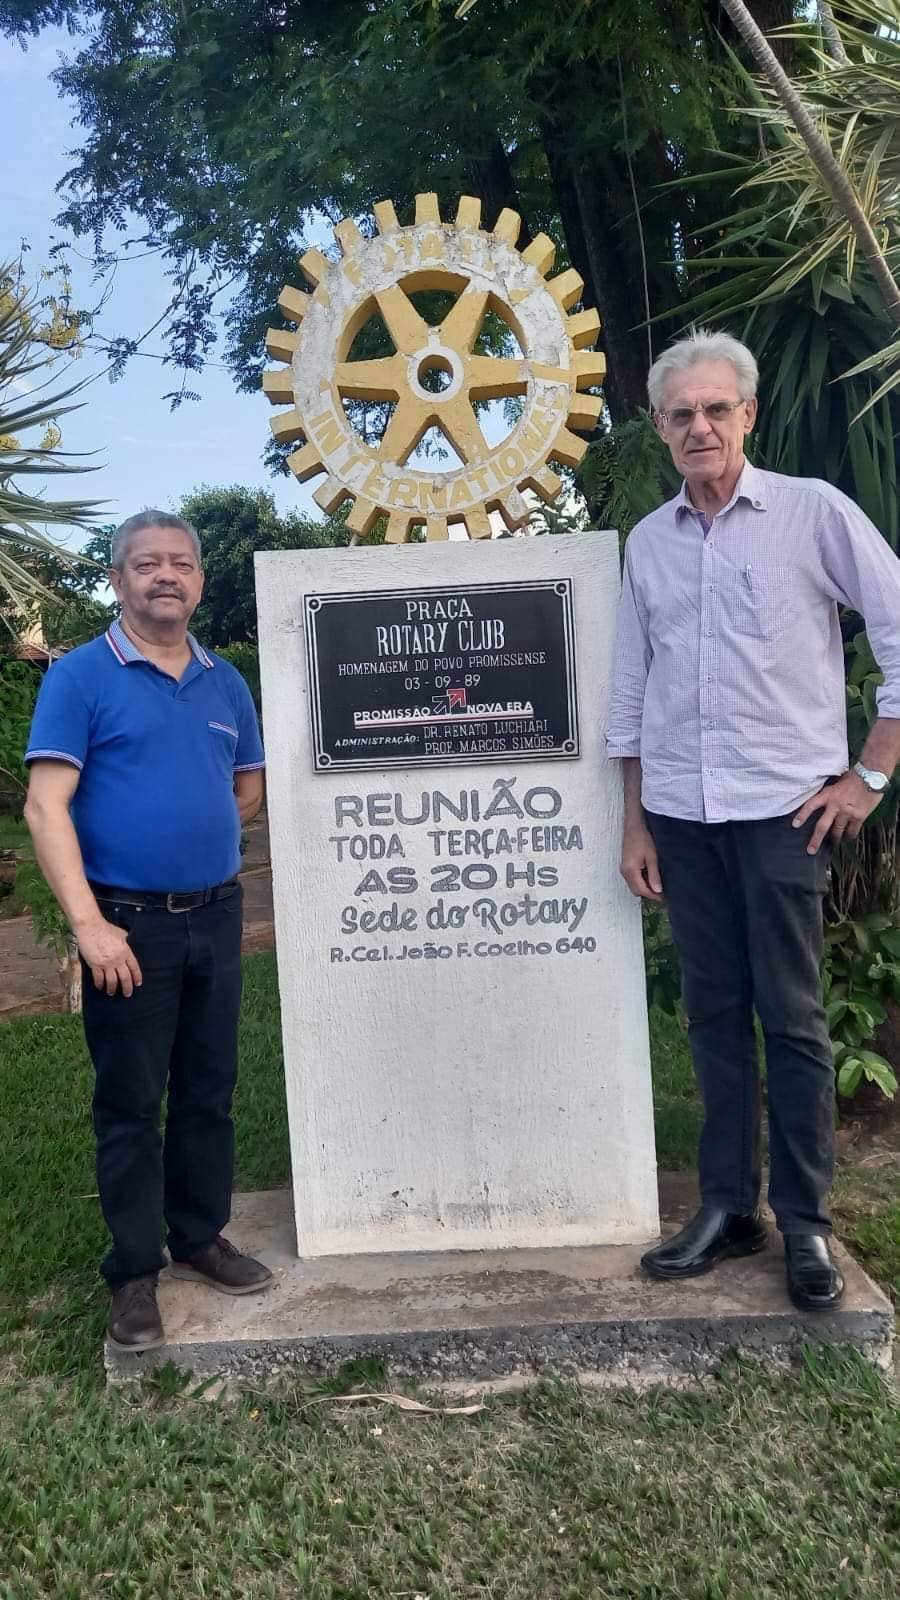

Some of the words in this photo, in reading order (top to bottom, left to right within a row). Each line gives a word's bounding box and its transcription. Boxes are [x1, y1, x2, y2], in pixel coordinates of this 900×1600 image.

[406, 598, 473, 621] PRAÇA
[376, 621, 448, 657] ROTARY
[458, 619, 505, 651] CLUB
[338, 660, 408, 676] HOMENAGEM
[415, 658, 429, 672] DO
[434, 656, 463, 671] POVO
[469, 652, 546, 668] PROMISSENSE
[353, 705, 431, 721] PROMISSÃO
[466, 702, 503, 714] NOVA
[507, 701, 534, 712] ERA
[424, 726, 442, 738] DR.
[445, 723, 488, 738] RENATO
[494, 720, 548, 735] LUCHIARI
[425, 741, 455, 755] PROF.
[460, 738, 506, 753] MARCOS
[512, 734, 554, 750] SIMÕES
[334, 777, 563, 828] REUNIÃO
[329, 833, 405, 862] TODA
[354, 866, 418, 896] AS
[430, 863, 497, 892] 20
[341, 902, 418, 934] Sede
[426, 898, 470, 930] do
[472, 893, 588, 935] Rotary
[555, 937, 597, 954] 640
